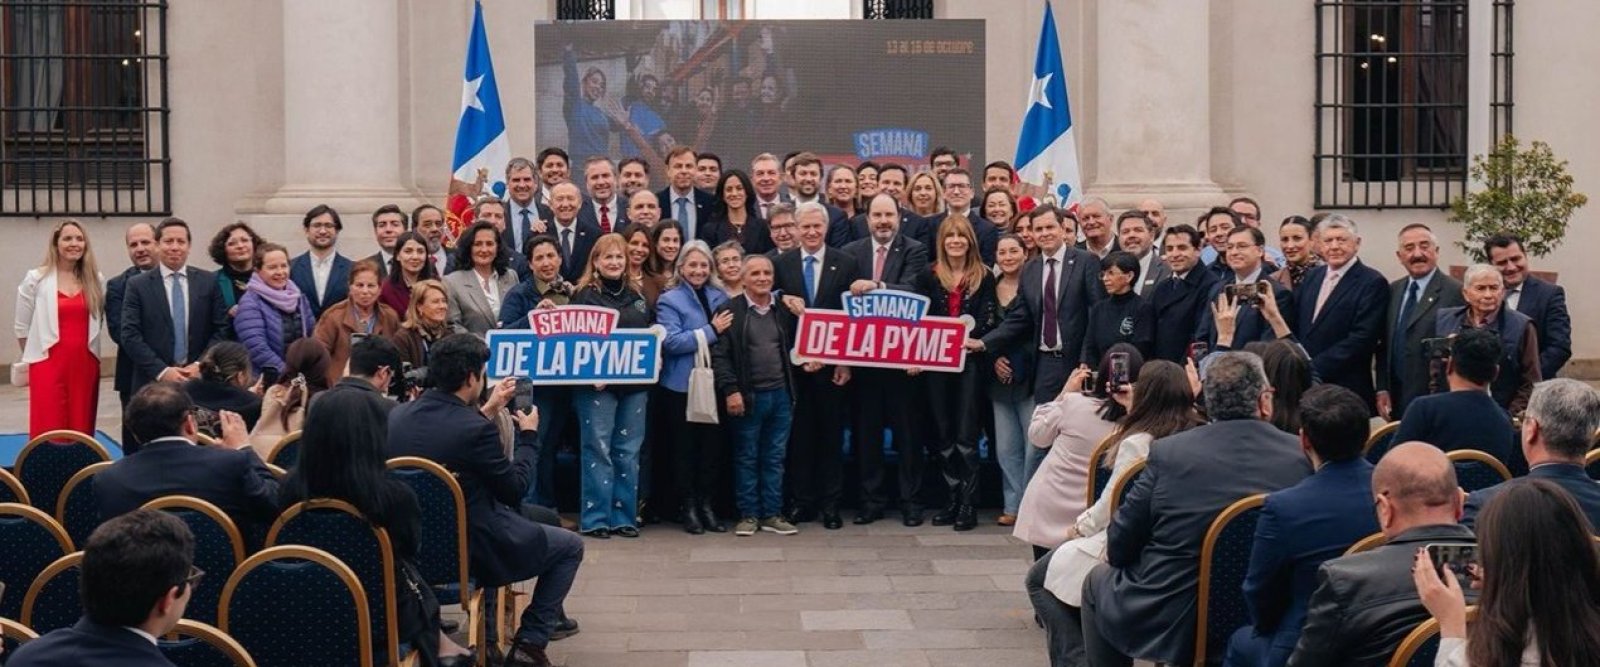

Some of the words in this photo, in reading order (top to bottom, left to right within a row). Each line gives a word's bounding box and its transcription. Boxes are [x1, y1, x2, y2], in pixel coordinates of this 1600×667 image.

[858, 132, 923, 158] SEMANA
[852, 296, 919, 321] SEMANA
[538, 311, 607, 335] SEMANA
[806, 320, 844, 355] DE
[845, 323, 877, 358] LA
[880, 325, 957, 363] PYME
[495, 341, 532, 377] DE
[536, 341, 567, 376] LA
[572, 340, 650, 376] PYME
